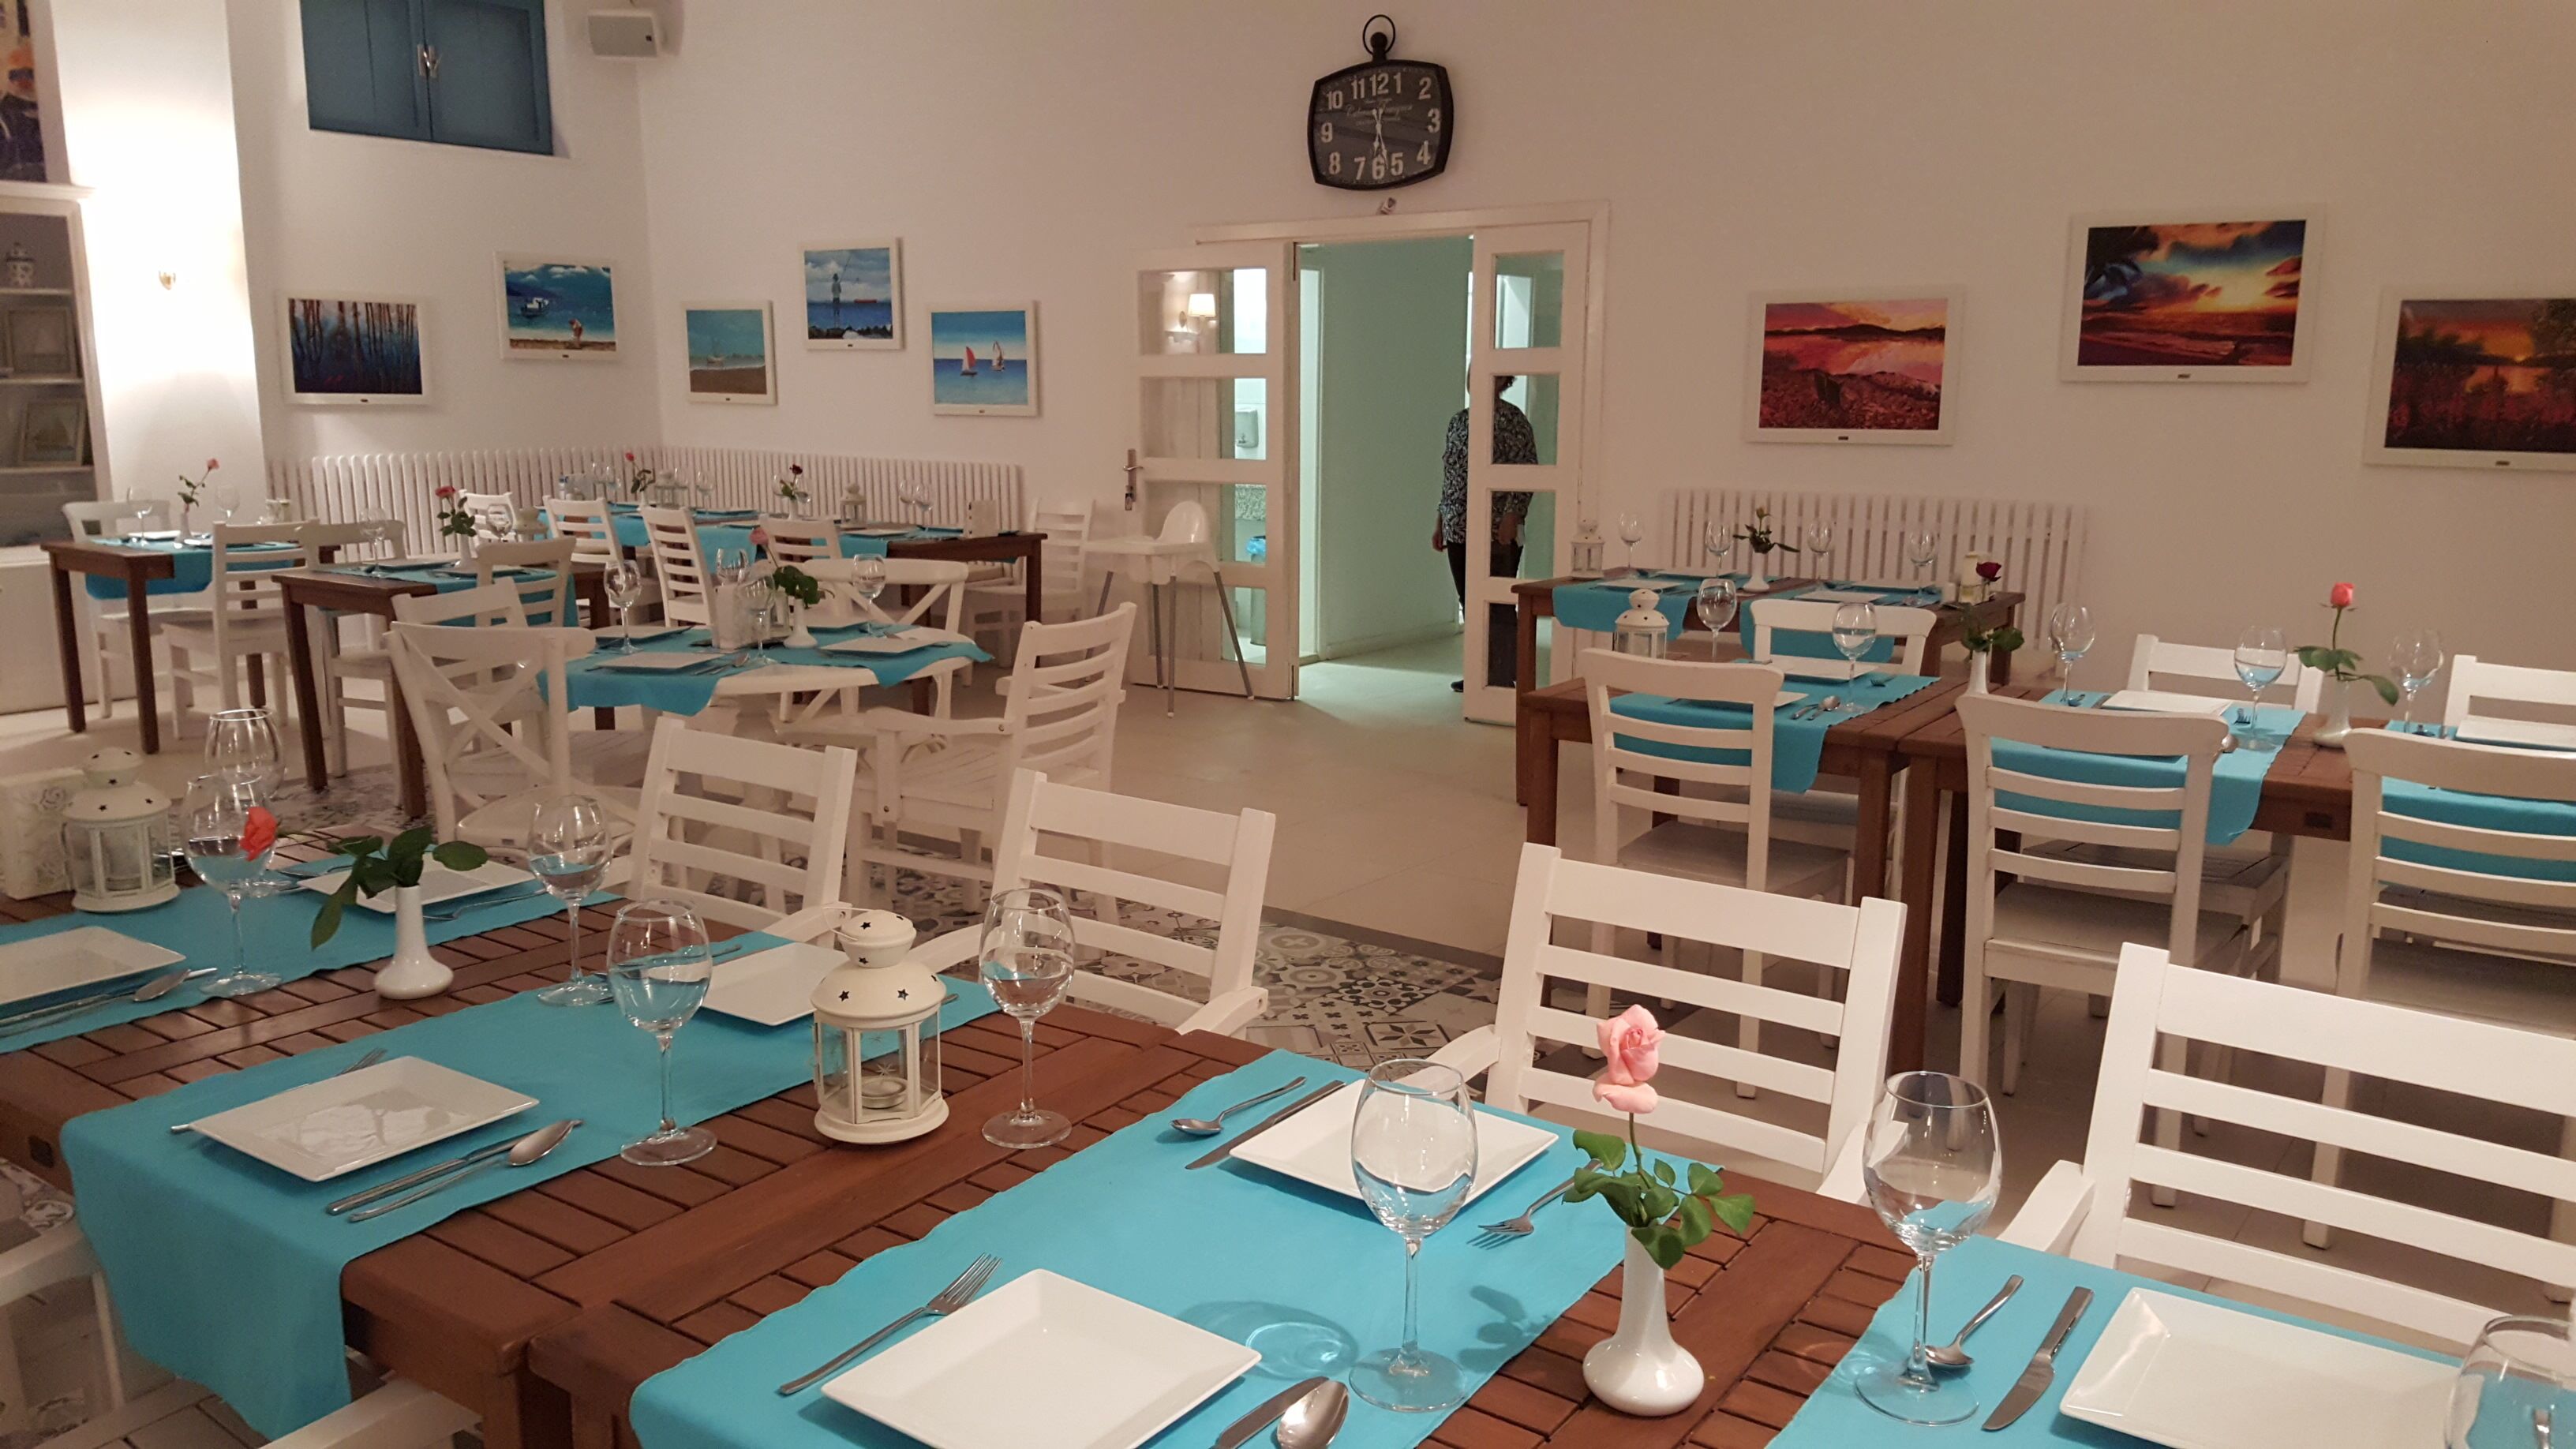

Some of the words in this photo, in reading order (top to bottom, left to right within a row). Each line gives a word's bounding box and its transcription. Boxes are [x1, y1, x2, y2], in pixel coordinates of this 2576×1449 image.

[1351, 77, 1365, 99] 11
[1370, 73, 1389, 96] 12
[1394, 73, 1402, 94] 1
[1418, 77, 1432, 100] 2
[1327, 90, 1343, 110] 10
[1427, 108, 1441, 133] 3
[1320, 122, 1333, 144] 9
[1328, 152, 1342, 175] 8
[1416, 140, 1430, 165] 4
[1354, 156, 1367, 181] 7
[1372, 155, 1385, 180] 6
[1390, 152, 1404, 177] 5
